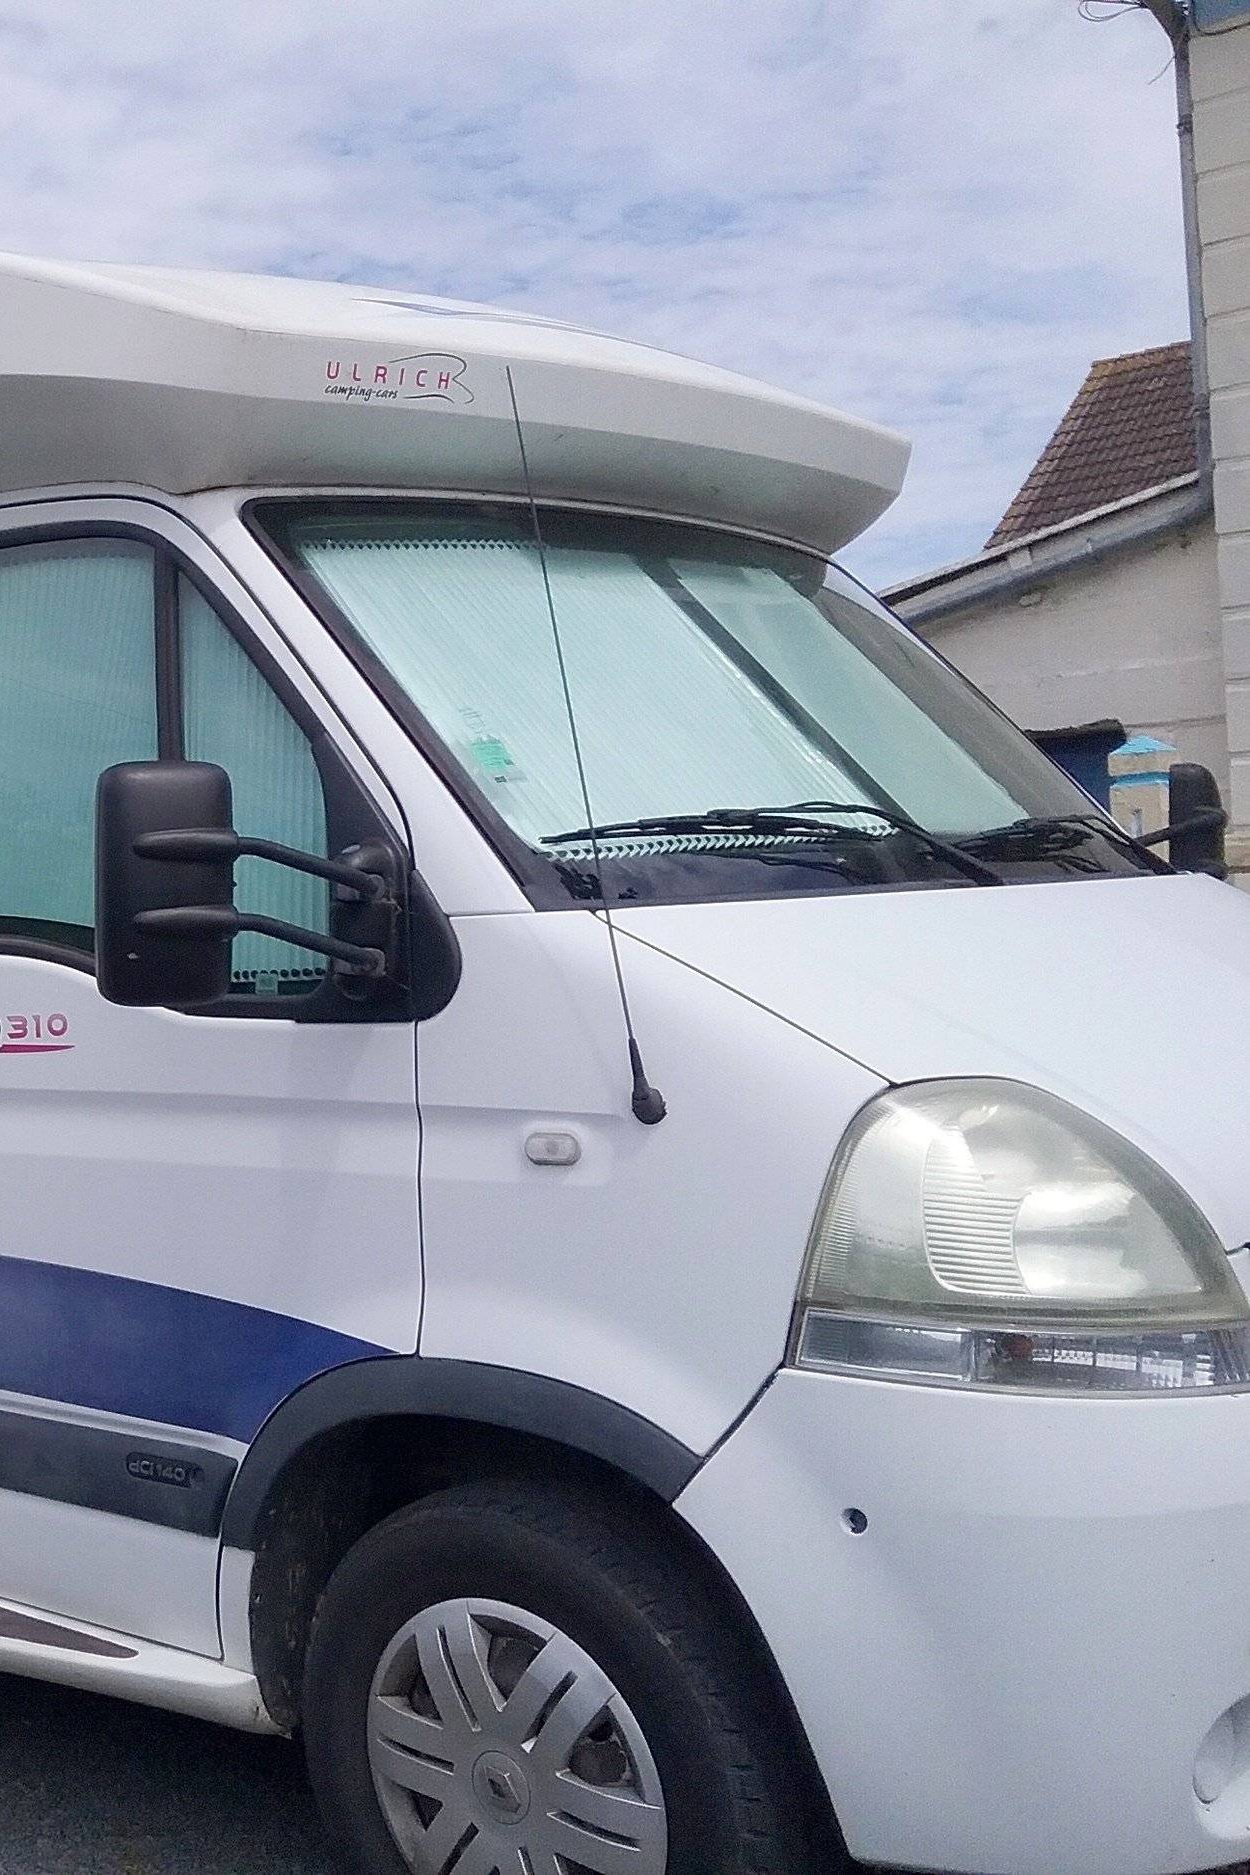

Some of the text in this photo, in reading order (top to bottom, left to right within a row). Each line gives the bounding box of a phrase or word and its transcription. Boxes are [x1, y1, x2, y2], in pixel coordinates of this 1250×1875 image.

[326, 360, 451, 390] ULRICH
[324, 383, 399, 401] camping-cars
[5, 1012, 69, 1040] 310
